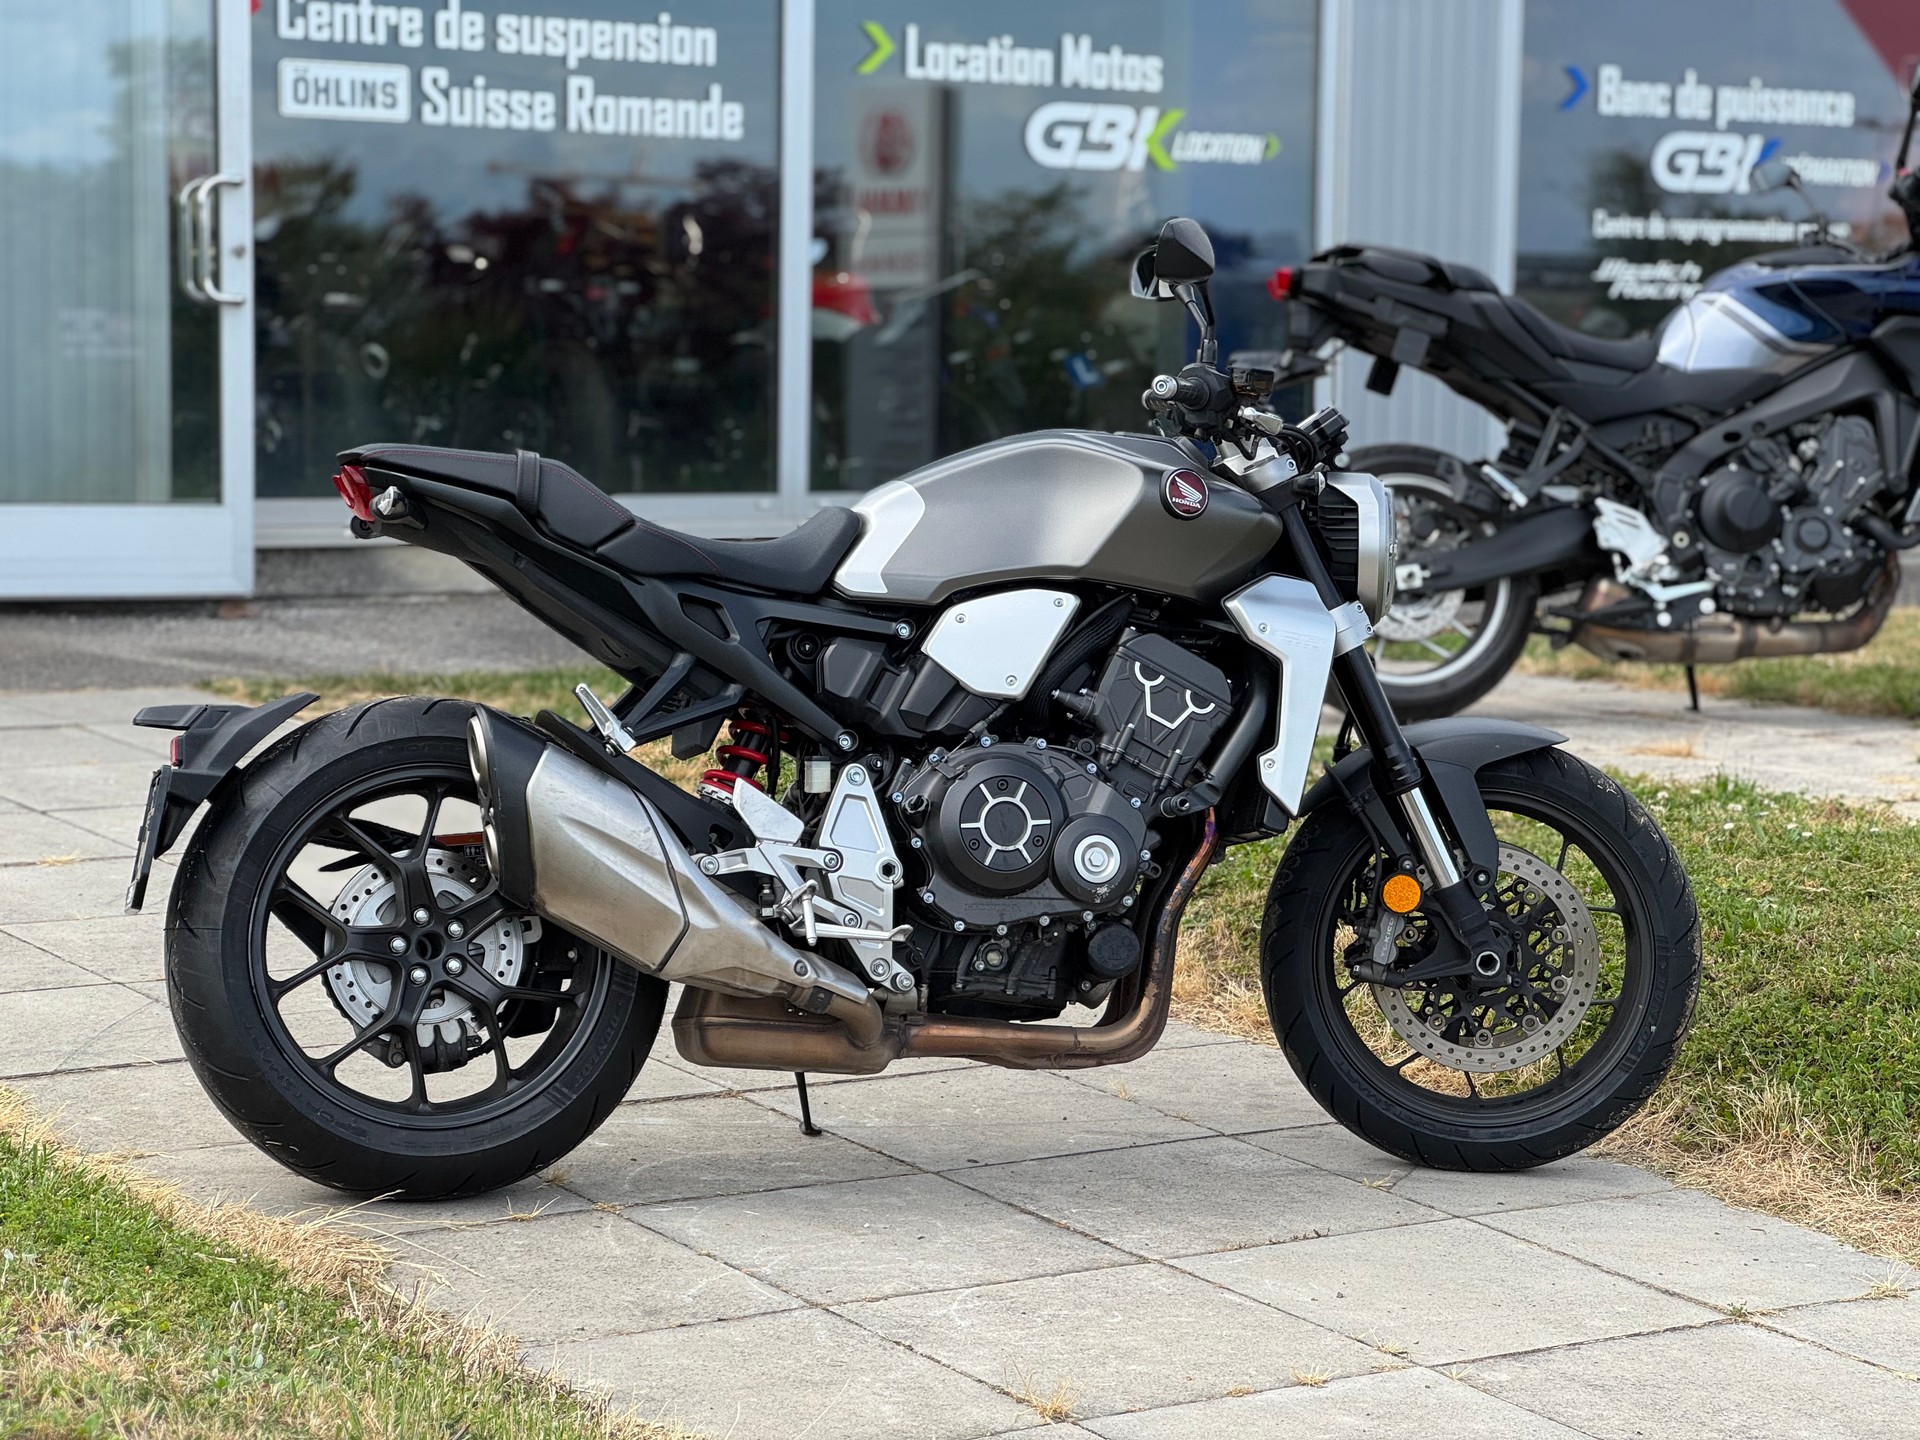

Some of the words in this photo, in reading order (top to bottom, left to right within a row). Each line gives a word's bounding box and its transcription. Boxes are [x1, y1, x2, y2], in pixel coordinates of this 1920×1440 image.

[277, 0, 423, 47] Centre
[434, 0, 485, 51] de
[496, 12, 718, 69] suspension
[905, 23, 1054, 88] Location
[1061, 33, 1164, 93] Motos
[293, 67, 399, 108] ÖHLINS
[420, 67, 556, 131] Suisse
[566, 75, 744, 140] Romande
[1597, 63, 1672, 118] Banc
[1674, 67, 1713, 121] de
[1715, 77, 1856, 131] puissance
[1171, 131, 1266, 165] LOCATION
[1592, 208, 1645, 240] Centre
[1647, 210, 1668, 241] de
[1172, 497, 1201, 508] HONDA
